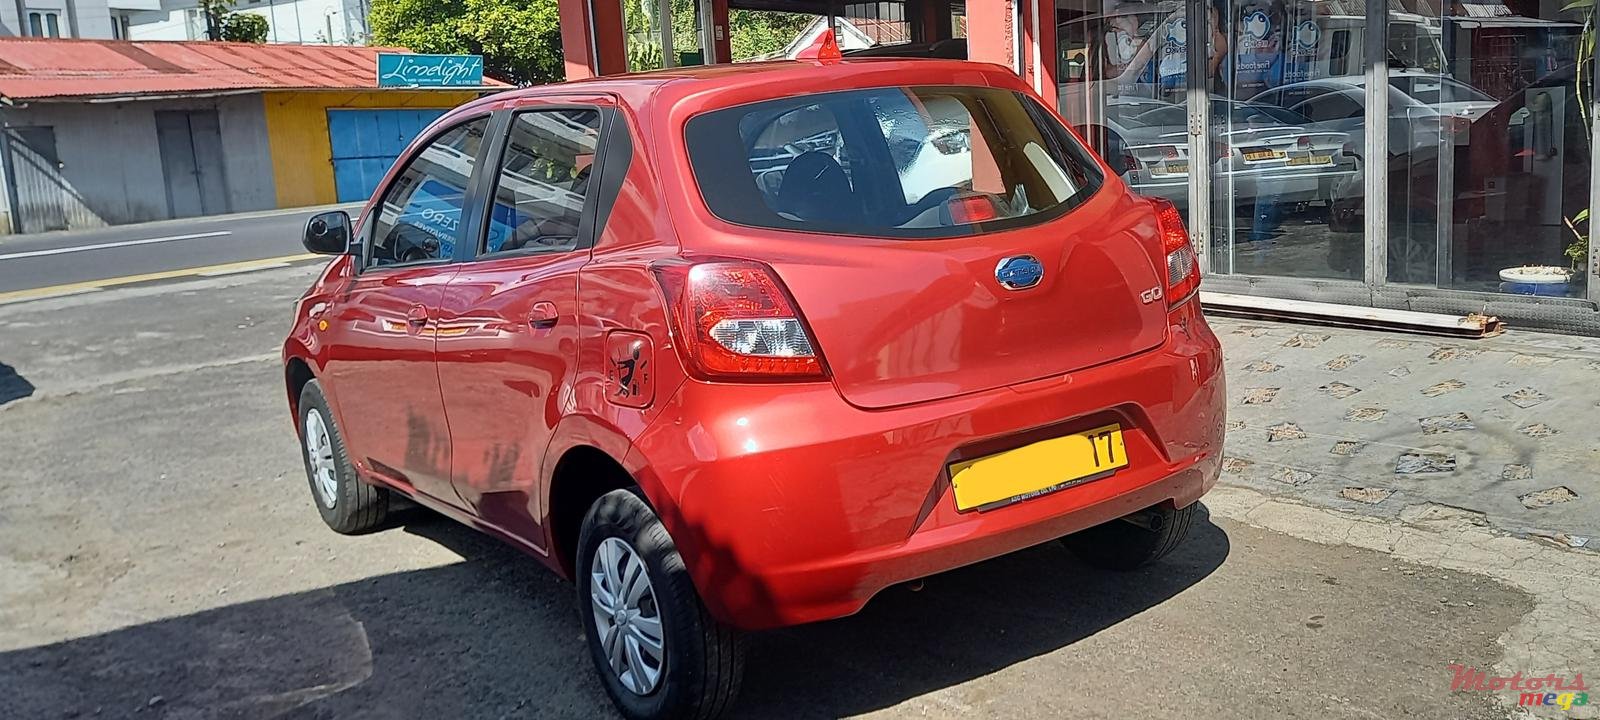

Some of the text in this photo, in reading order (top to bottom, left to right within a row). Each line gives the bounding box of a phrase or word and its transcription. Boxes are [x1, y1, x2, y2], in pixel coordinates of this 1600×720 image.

[381, 56, 480, 85] Limelight
[1140, 285, 1163, 304] GO
[1088, 431, 1114, 467] 17
